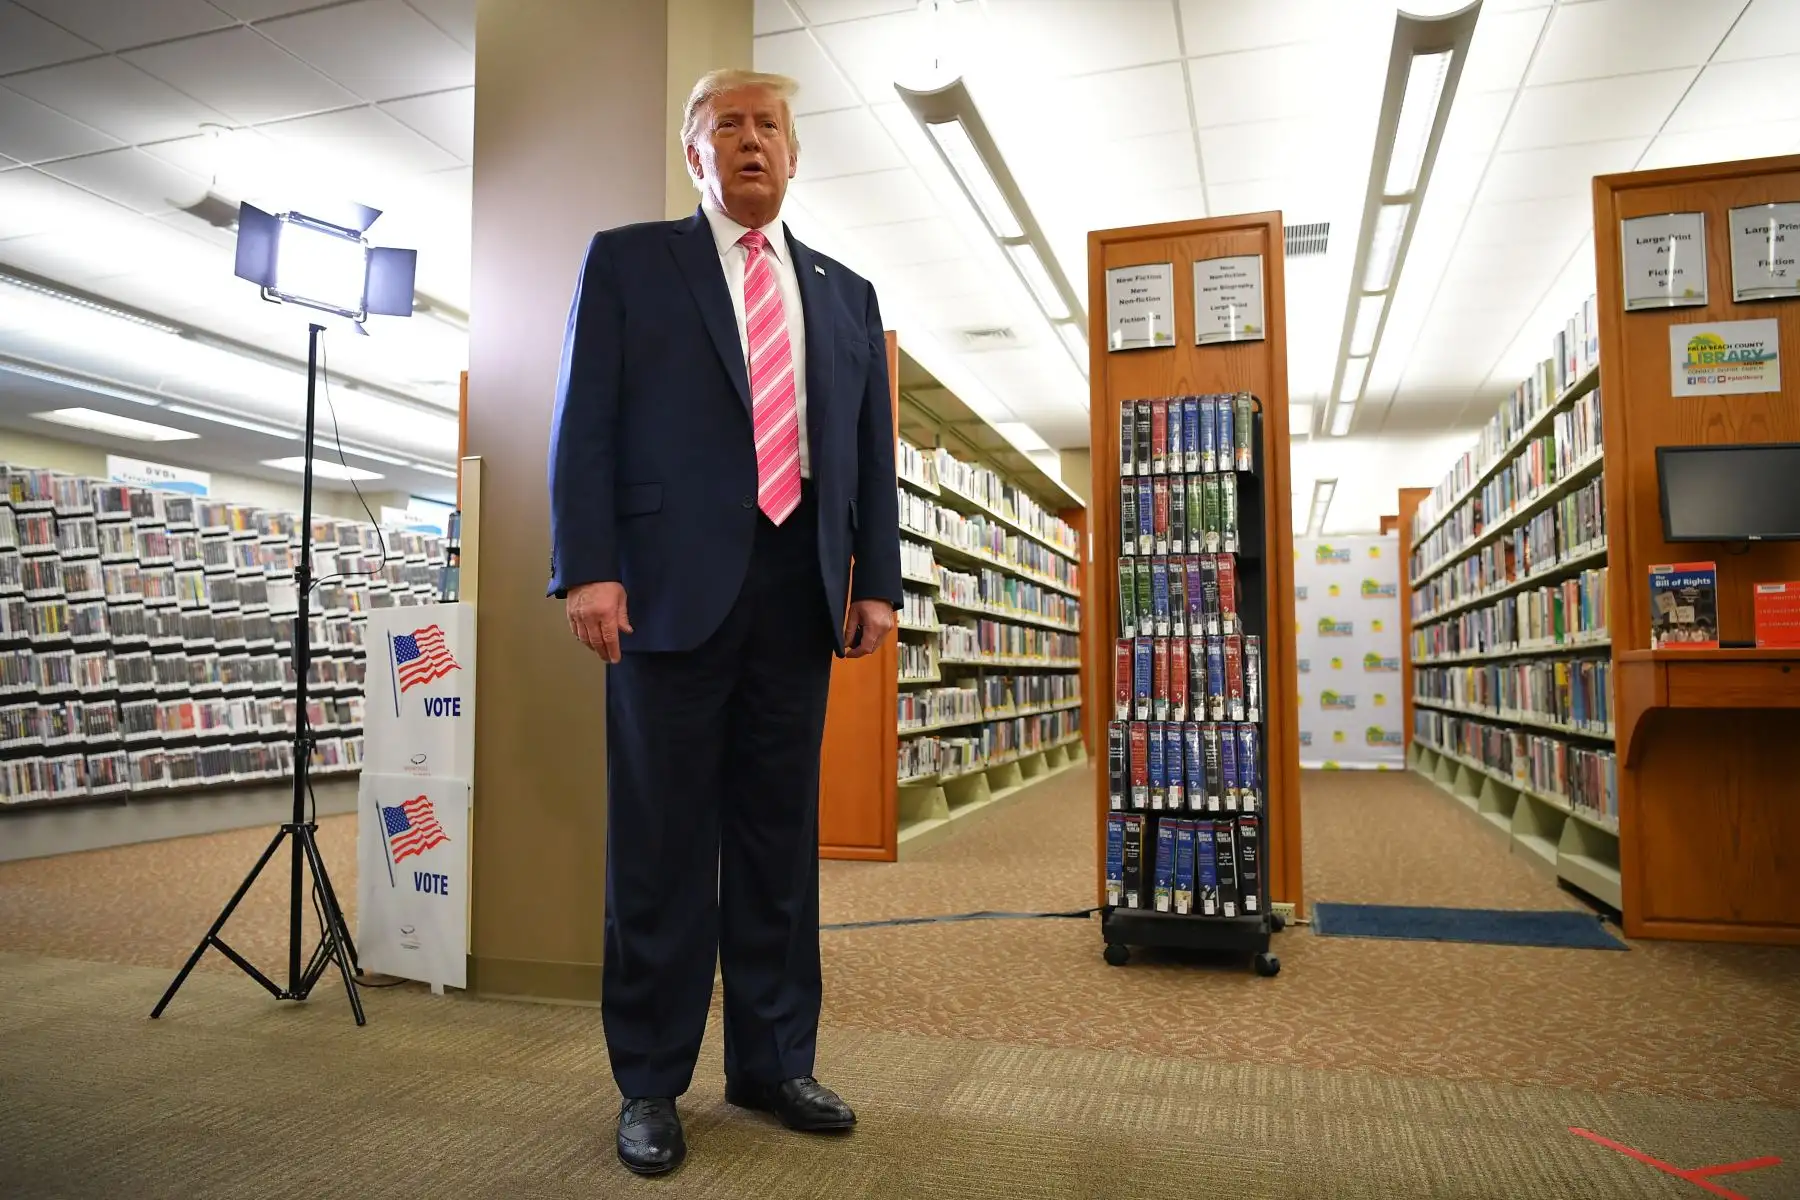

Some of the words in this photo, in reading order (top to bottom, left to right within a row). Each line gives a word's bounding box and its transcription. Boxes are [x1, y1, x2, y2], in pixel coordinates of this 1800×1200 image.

[1636, 236, 1665, 245] Large
[1648, 268, 1684, 277] Ficton
[1119, 316, 1146, 324] Fiction
[1709, 343, 1732, 351] BEACH
[1734, 340, 1764, 349] COUNTY
[1687, 348, 1764, 365] LIBRARY
[1655, 579, 1669, 587] Bill
[1671, 578, 1681, 586] of
[1683, 577, 1711, 586] Rights
[424, 697, 461, 717] VOTE
[414, 871, 449, 896] VOTE
